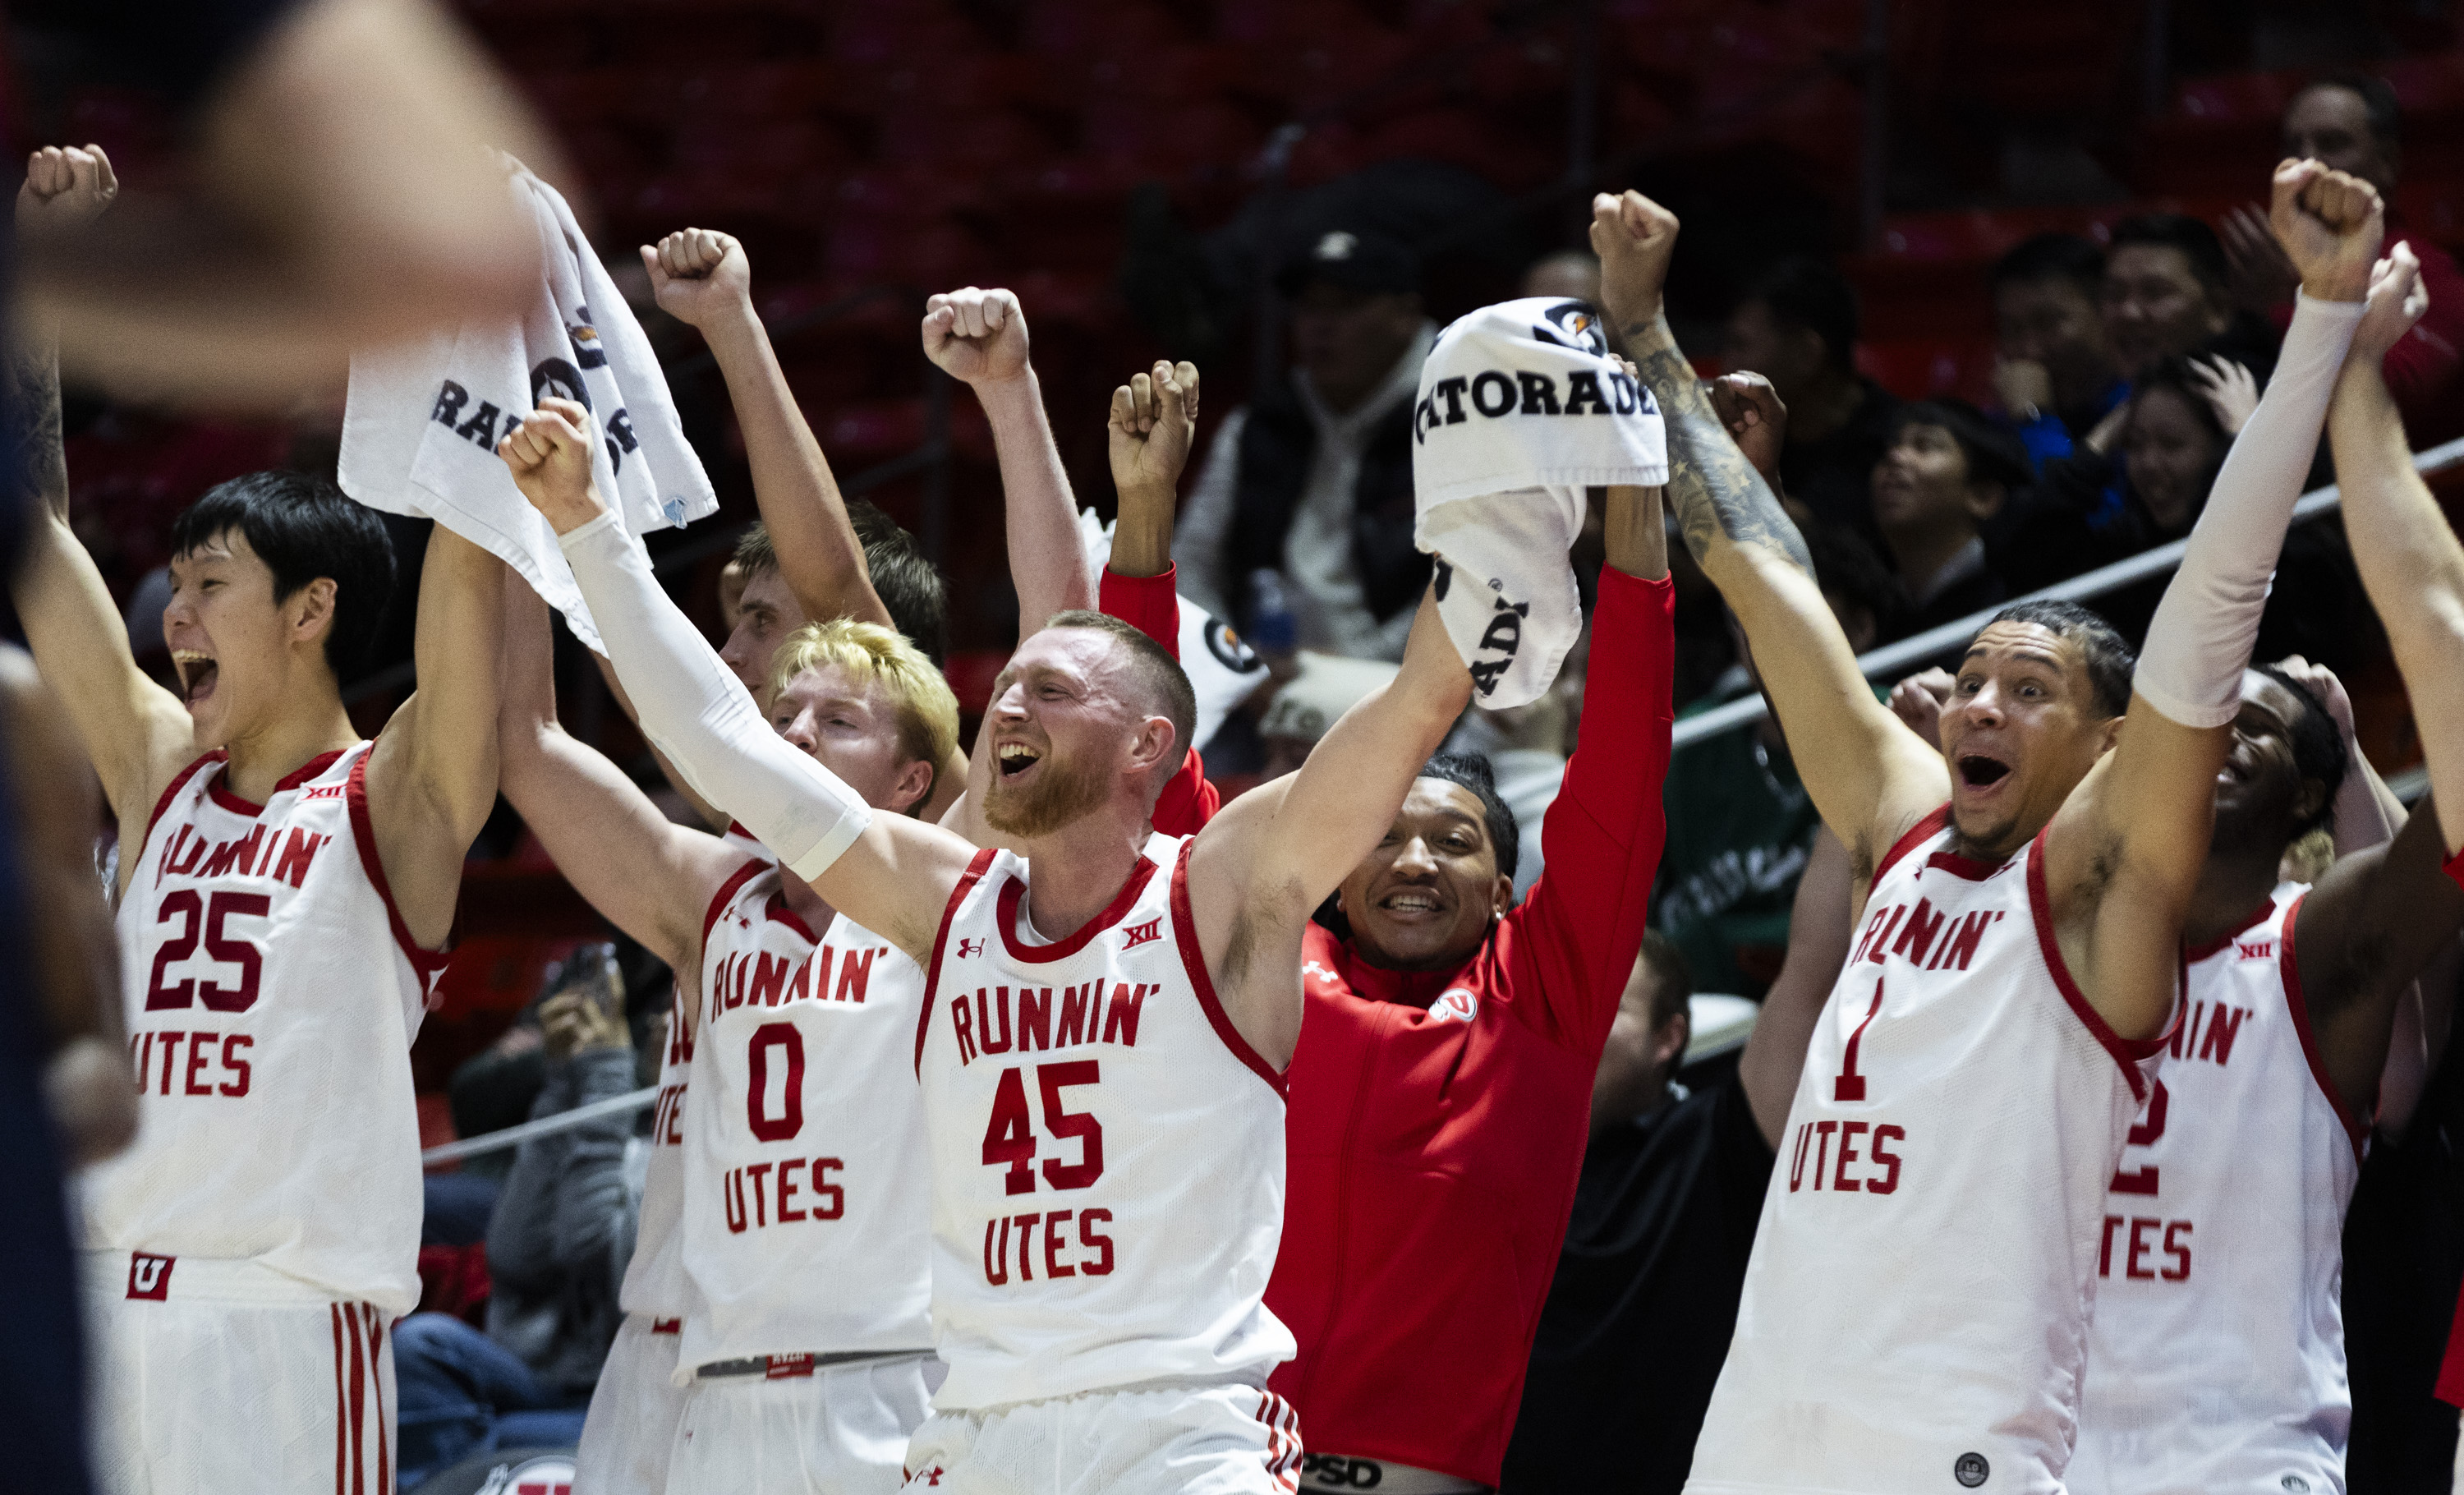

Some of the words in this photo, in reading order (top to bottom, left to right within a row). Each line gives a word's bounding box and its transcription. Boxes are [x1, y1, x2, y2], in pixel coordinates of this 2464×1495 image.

[145, 888, 271, 1013] 25
[1122, 916, 1162, 951] XII
[2239, 942, 2272, 960] XII
[711, 944, 889, 1024] RUNNIN'
[951, 978, 1161, 1066] RUNNIN'
[131, 1031, 254, 1098] UTES
[1834, 974, 1884, 1102] 1
[747, 1021, 805, 1143] 0
[982, 1060, 1104, 1196] 45
[1790, 1120, 1905, 1194] UTES
[725, 1157, 844, 1235] UTES
[135, 1258, 167, 1293] U
[984, 1208, 1114, 1286] UTES
